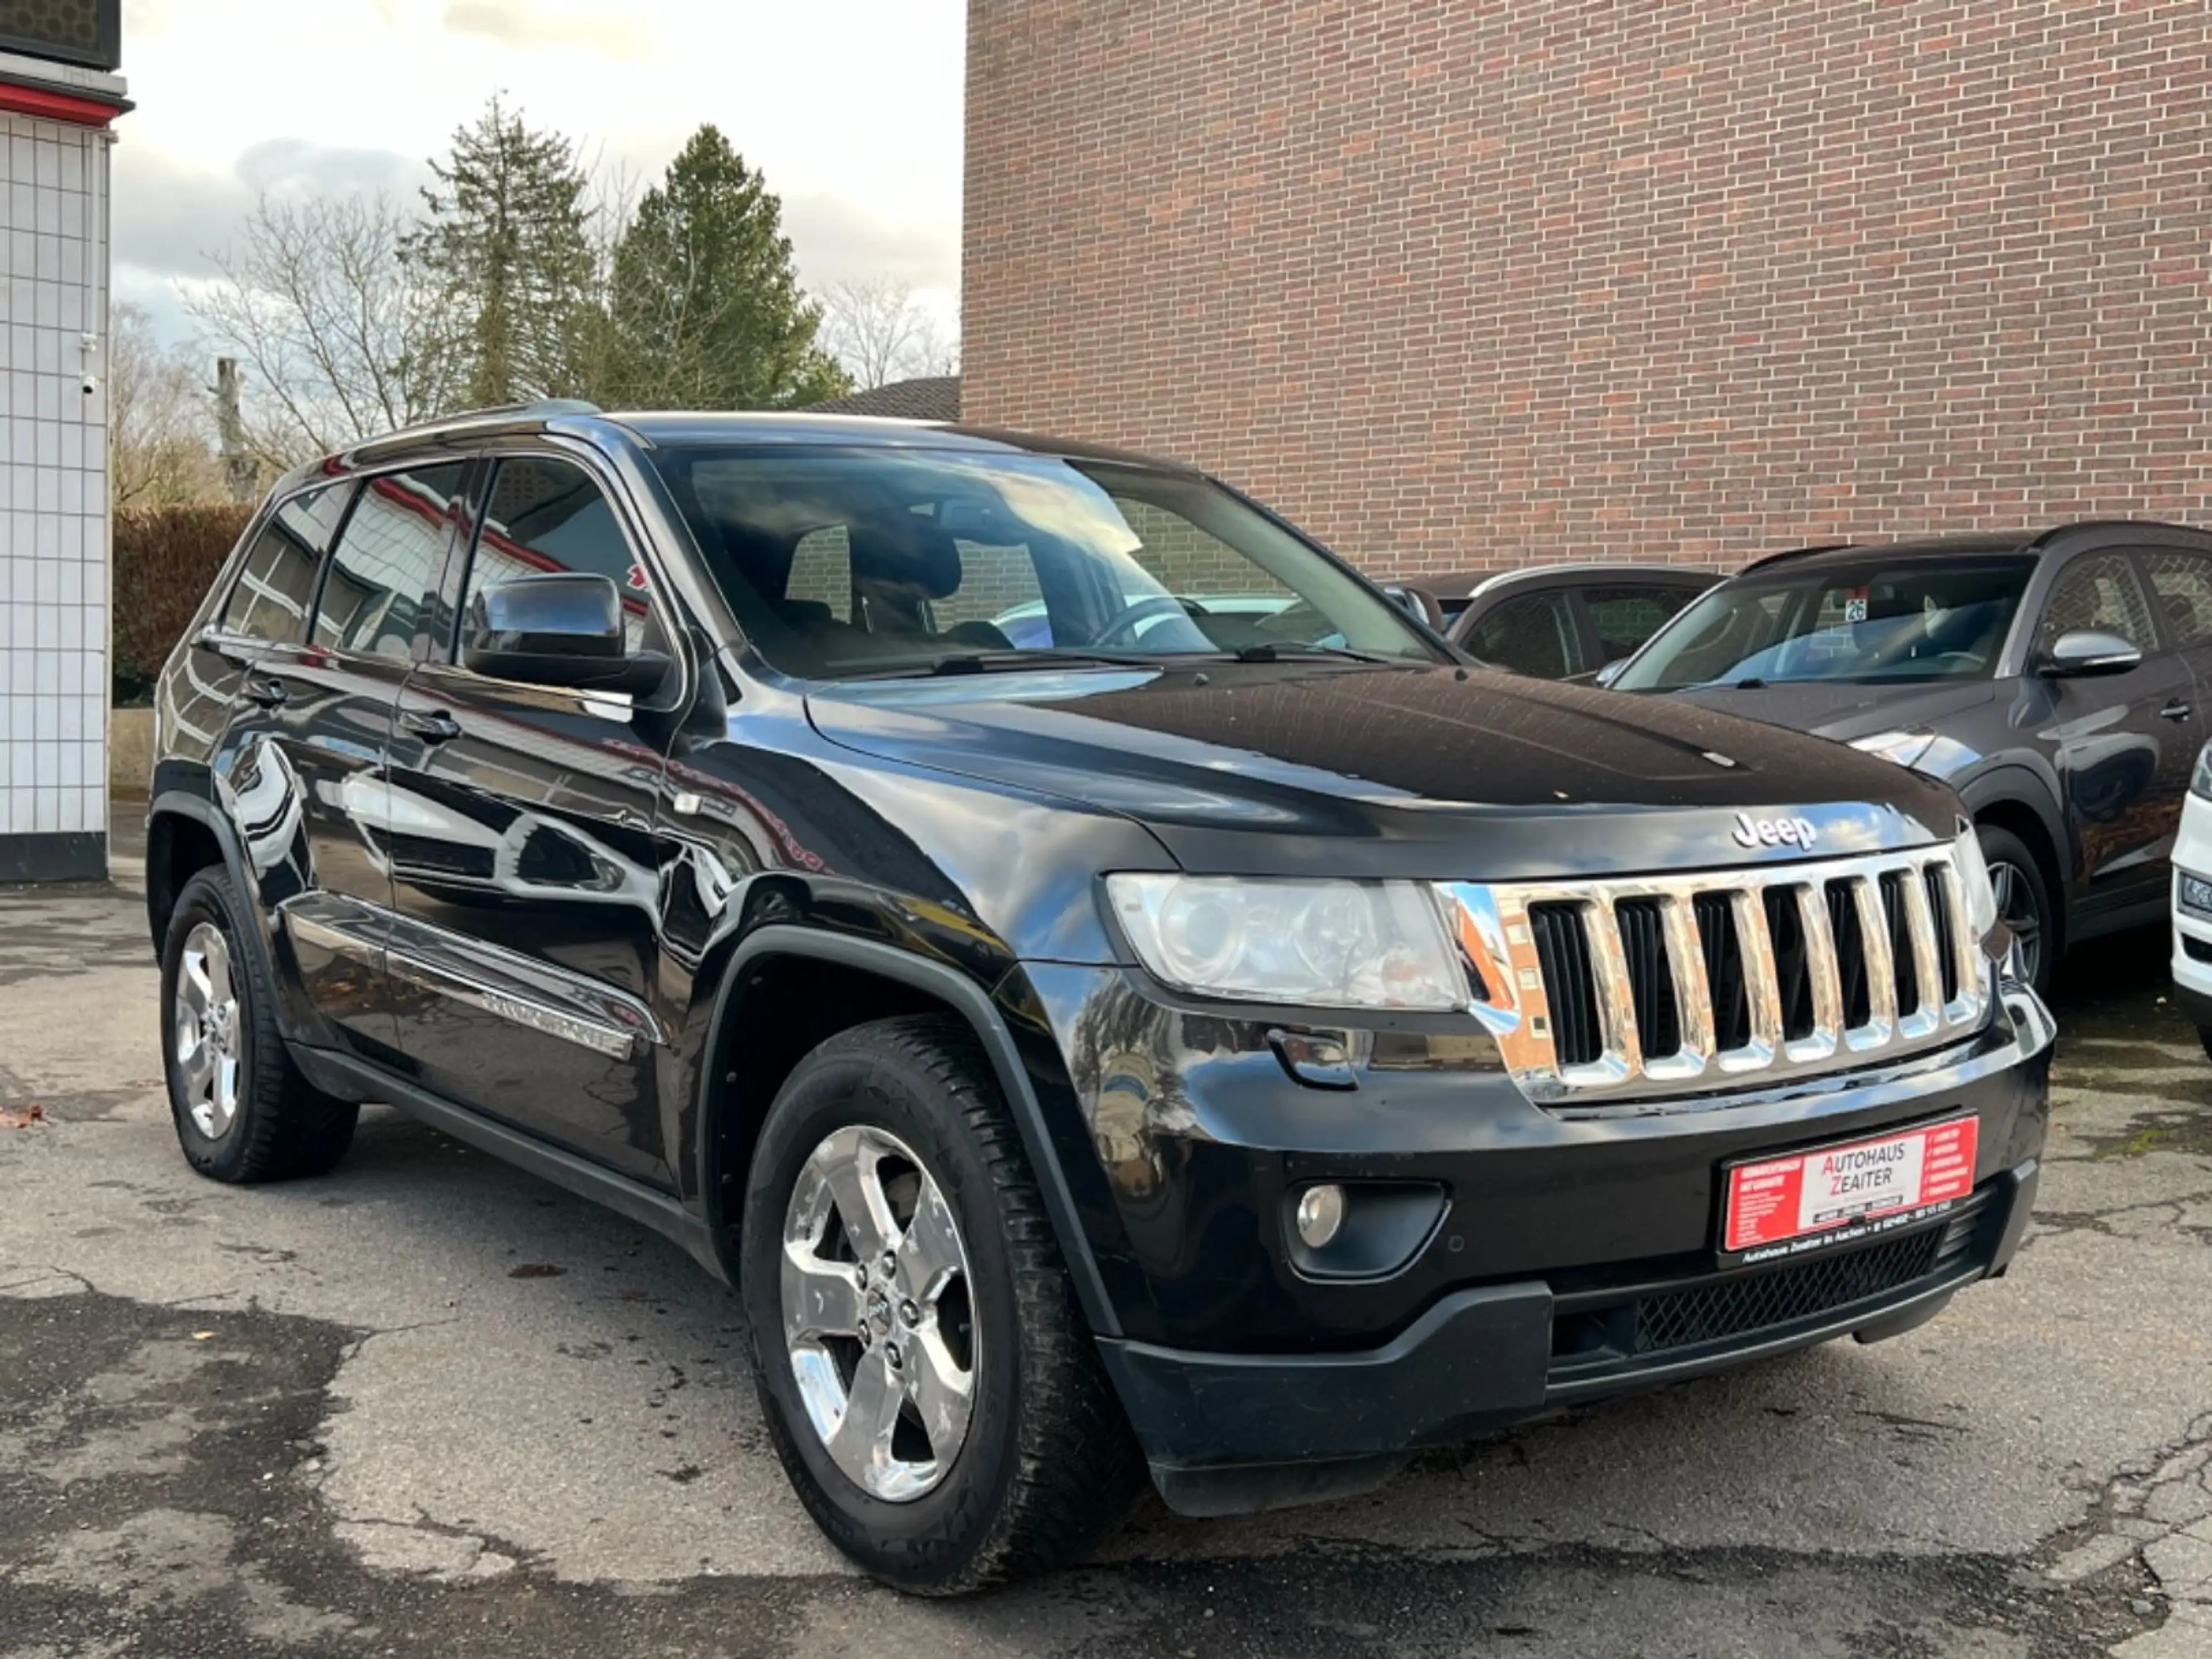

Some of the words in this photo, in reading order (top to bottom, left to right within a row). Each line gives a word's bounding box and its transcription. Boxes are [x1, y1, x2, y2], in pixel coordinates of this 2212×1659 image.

[1731, 813, 1816, 852] Jeep
[1821, 1143, 1905, 1176] AUTOHAUS
[1830, 1167, 1892, 1196] ZEAITER
